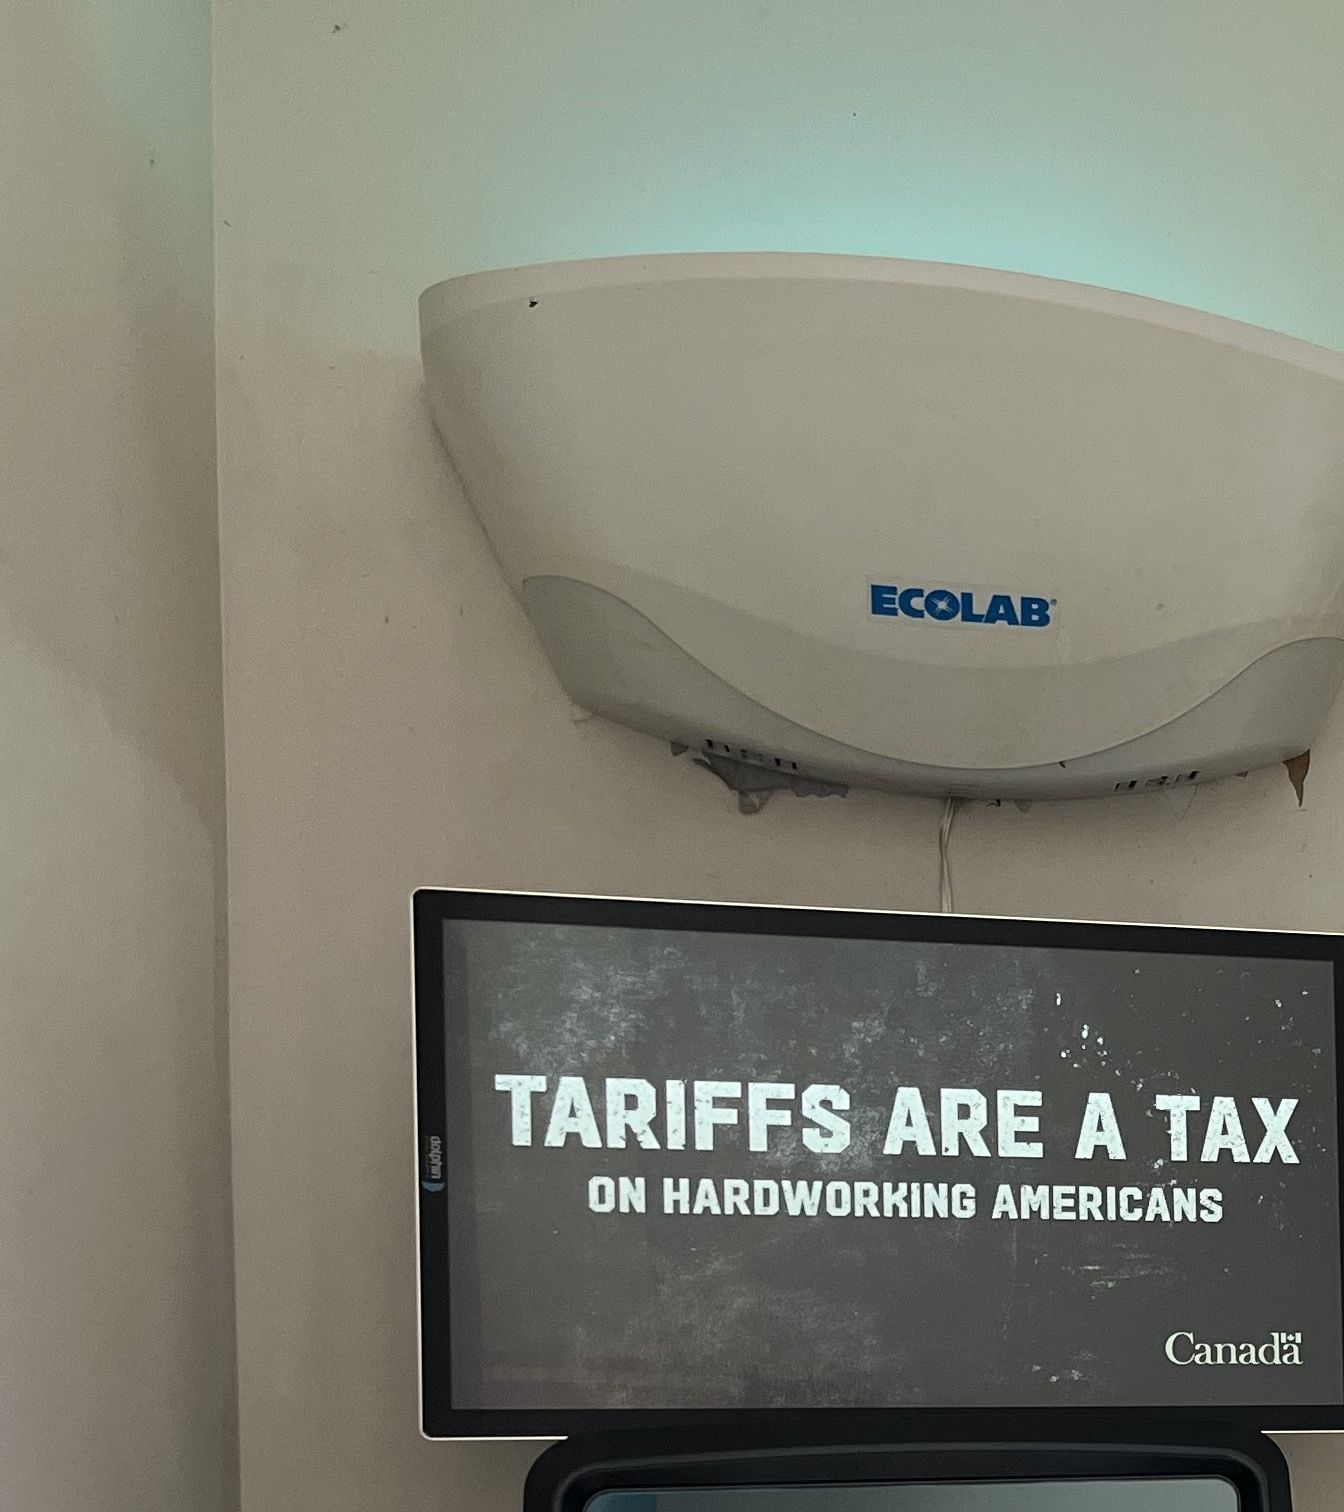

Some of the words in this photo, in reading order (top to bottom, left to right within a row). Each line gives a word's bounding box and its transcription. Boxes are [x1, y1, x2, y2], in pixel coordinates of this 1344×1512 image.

[871, 584, 1051, 627] ECOLAB
[494, 1074, 853, 1155] TARIFFS
[882, 1087, 1044, 1159] ARE
[1073, 1092, 1127, 1161] A
[1154, 1094, 1300, 1165] TAX
[429, 1135, 443, 1179] dolphin
[587, 1175, 646, 1213] ON
[661, 1178, 977, 1219] HARDWORKING
[990, 1183, 1224, 1223] AMERICANS
[1164, 1331, 1304, 1366] Canada
